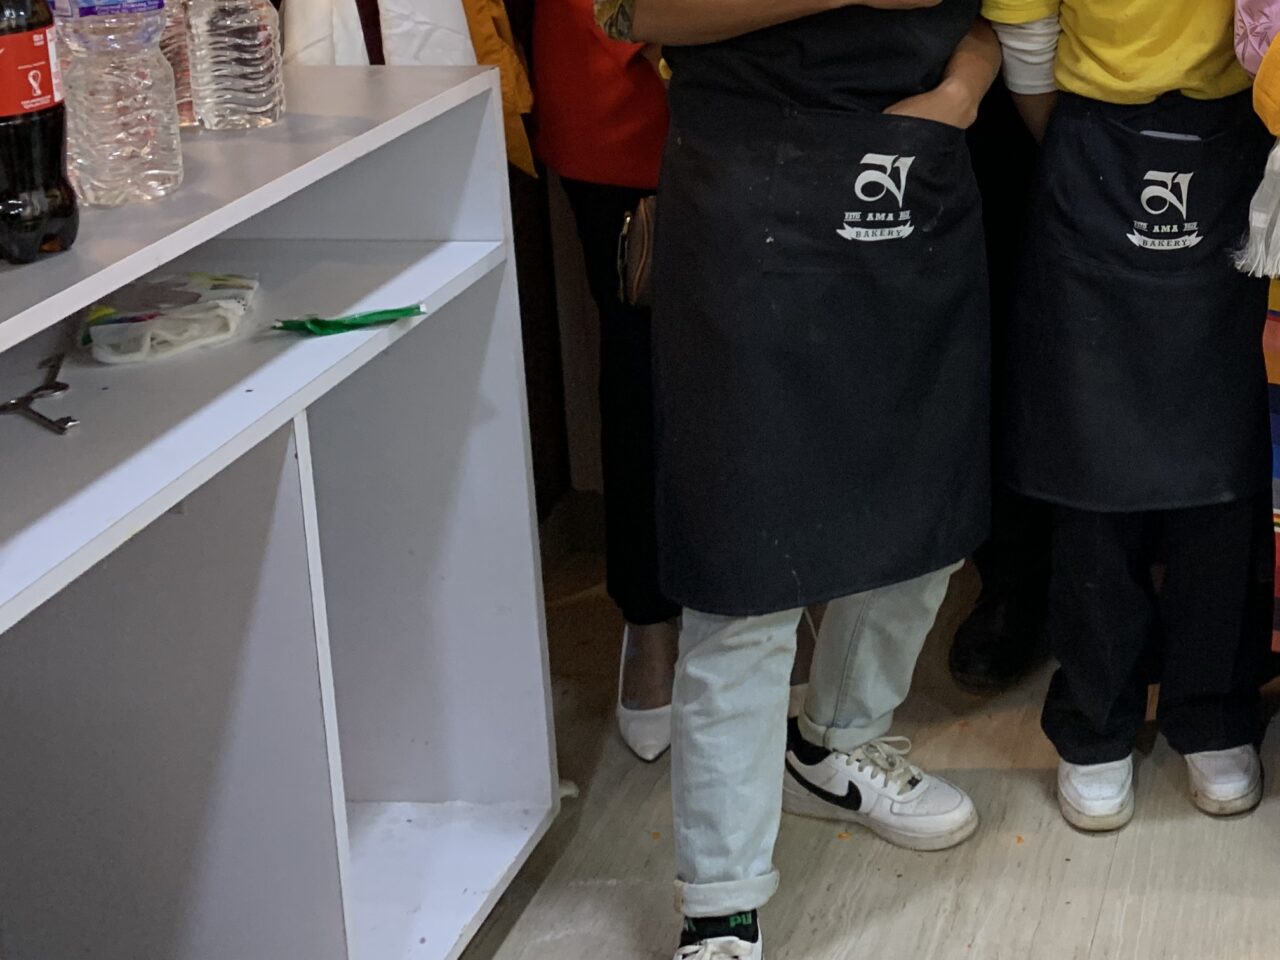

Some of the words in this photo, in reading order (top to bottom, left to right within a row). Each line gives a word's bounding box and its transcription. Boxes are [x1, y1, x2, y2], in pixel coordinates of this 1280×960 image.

[866, 212, 894, 221] AMA
[1152, 224, 1179, 233] AMA
[855, 228, 903, 239] BAKERY
[1142, 239, 1188, 247] BAKERY
